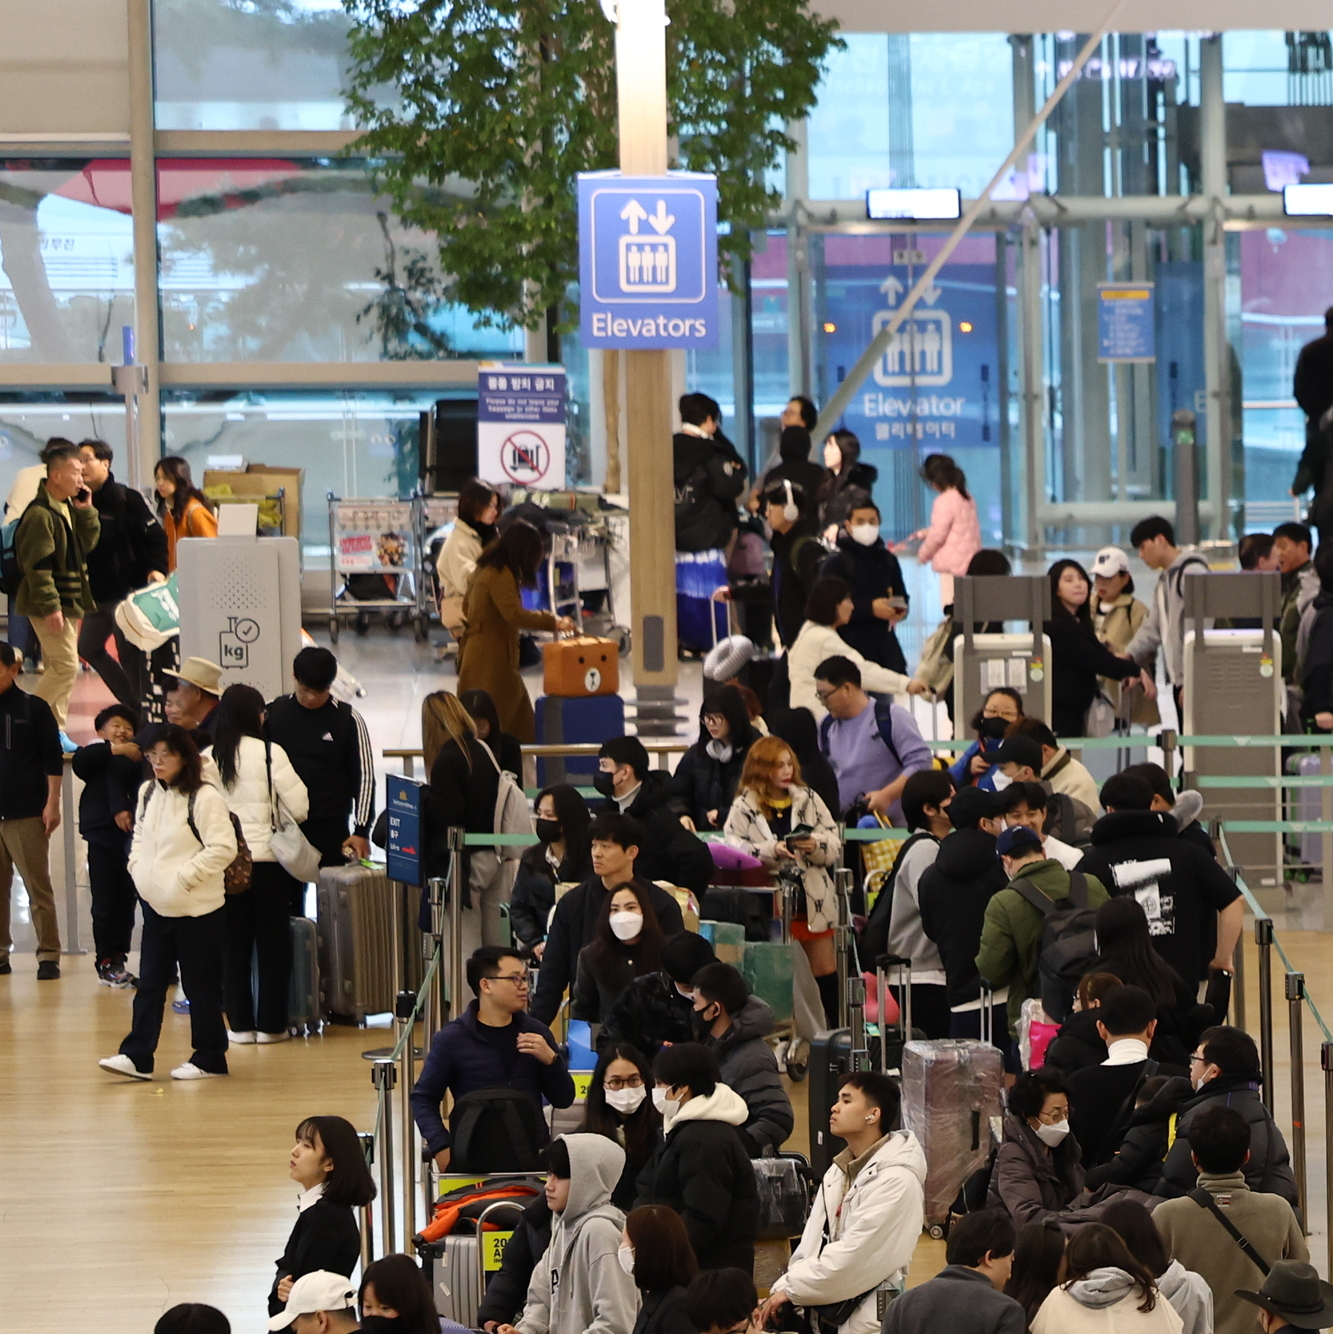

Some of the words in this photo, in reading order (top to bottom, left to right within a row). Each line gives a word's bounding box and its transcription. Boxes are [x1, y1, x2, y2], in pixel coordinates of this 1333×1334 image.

[592, 312, 706, 337] Elevators
[863, 392, 965, 417] Elevator
[225, 643, 246, 661] kg
[390, 817, 401, 827] EXIT
